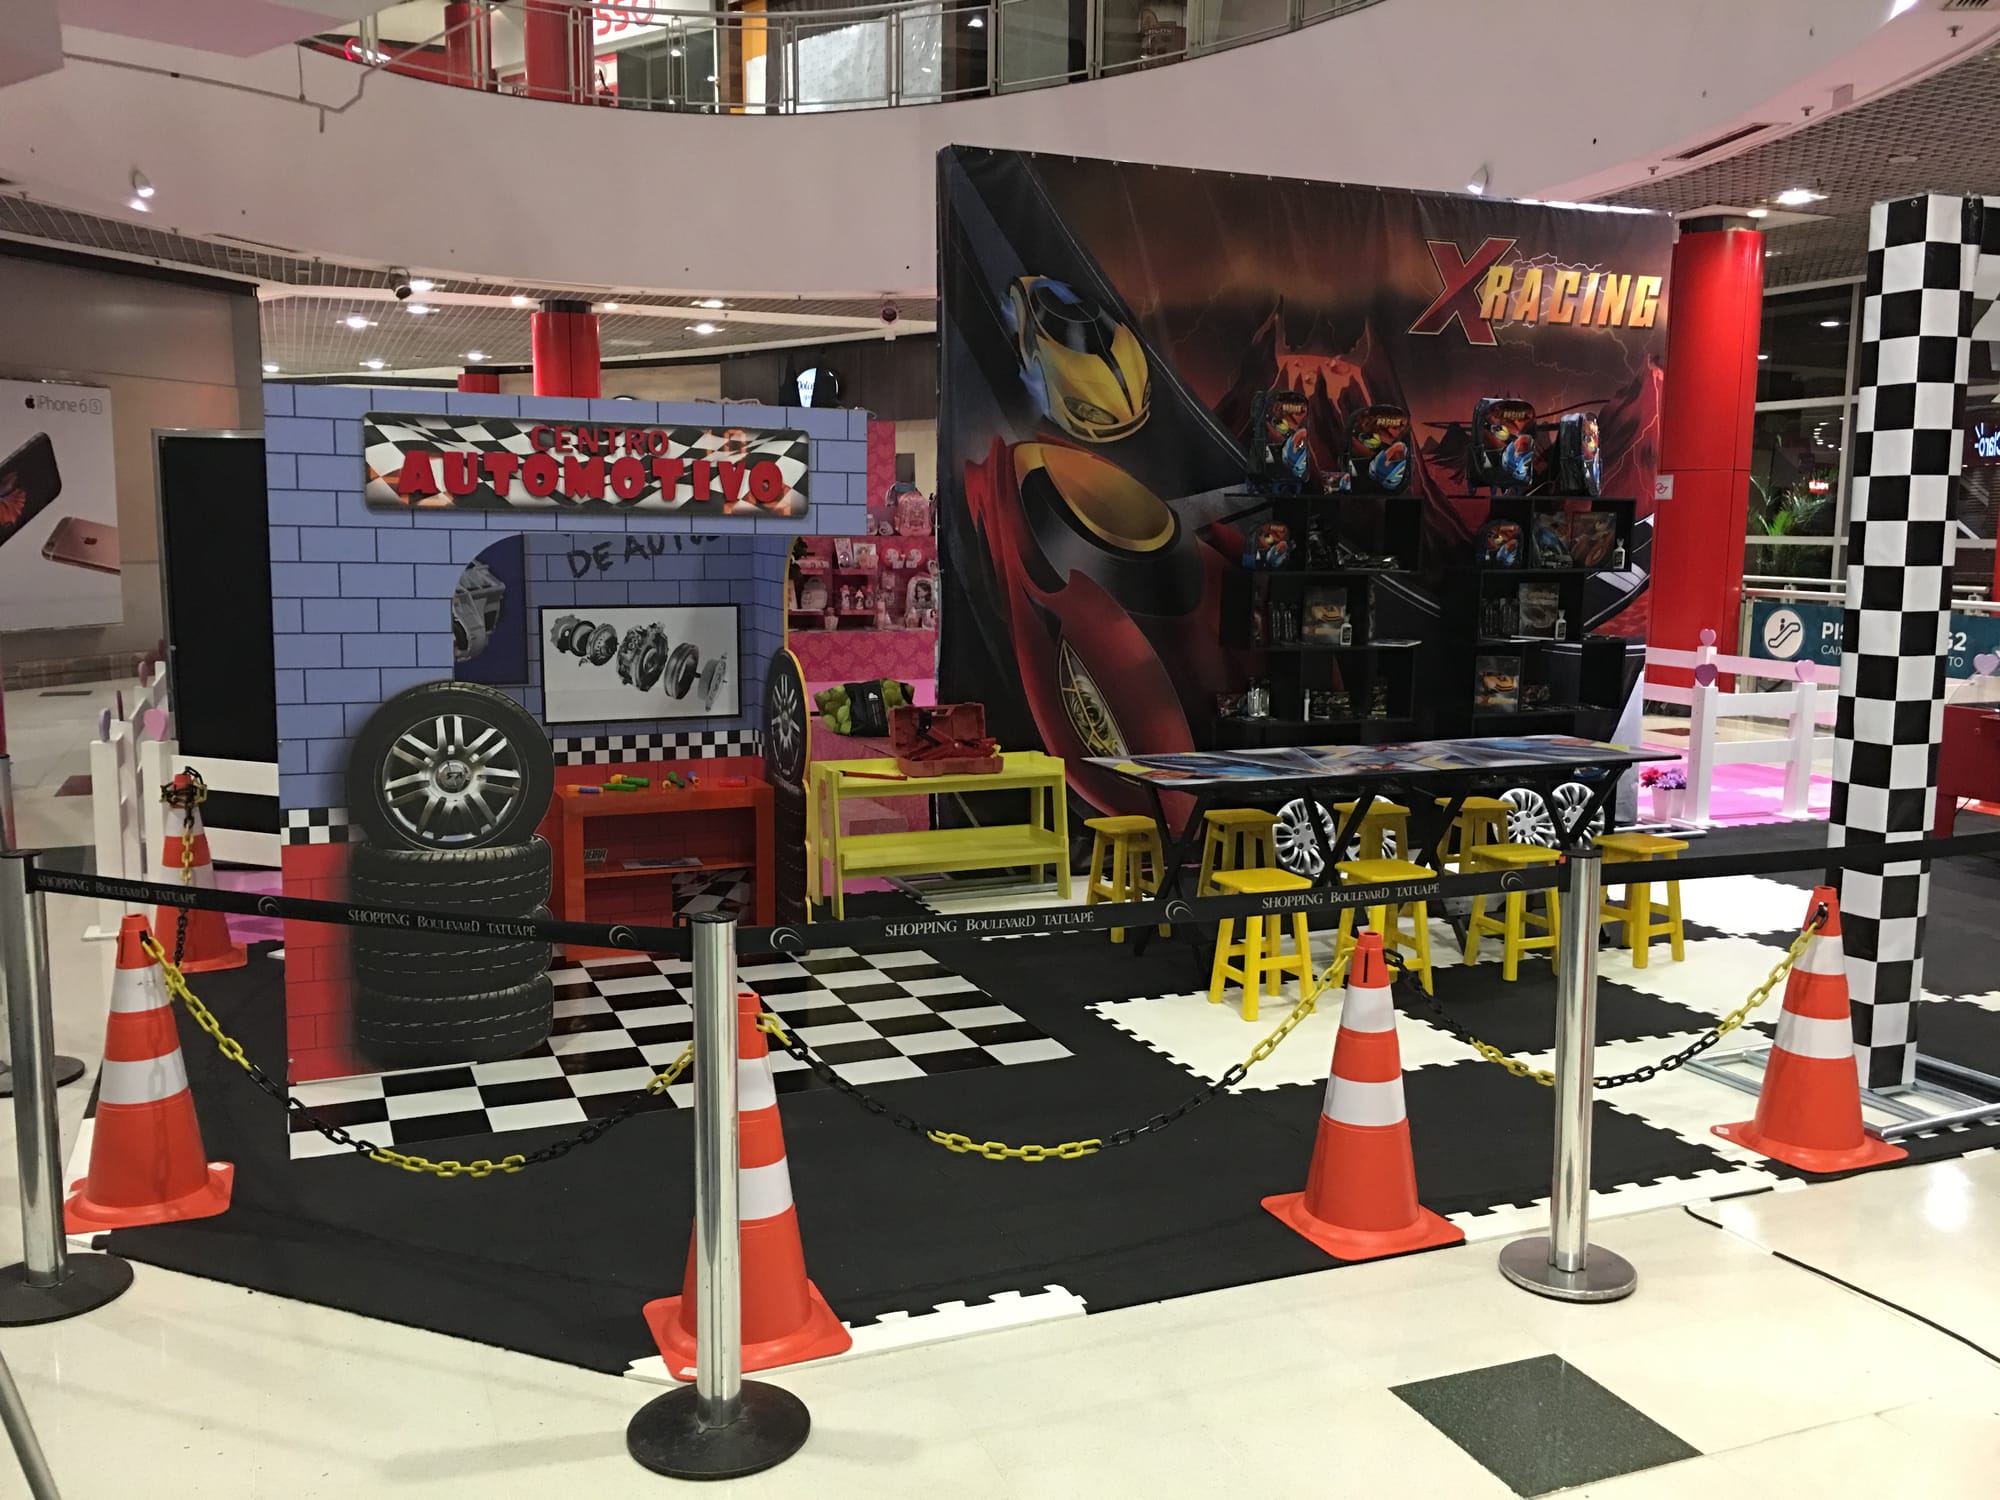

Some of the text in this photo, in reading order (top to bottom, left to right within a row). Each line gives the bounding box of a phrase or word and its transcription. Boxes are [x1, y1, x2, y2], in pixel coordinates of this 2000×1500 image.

[1480, 265, 1663, 328] RACING
[36, 395, 77, 412] iPhone
[530, 425, 669, 457] CENTRO
[398, 450, 783, 502] AUTOMOTIVO
[567, 541, 613, 578] DE
[1262, 892, 1324, 909] SHOPPING
[348, 909, 410, 926] SHOPPING
[885, 920, 957, 937] SHOPPING
[966, 914, 1036, 931] BOULEVARD
